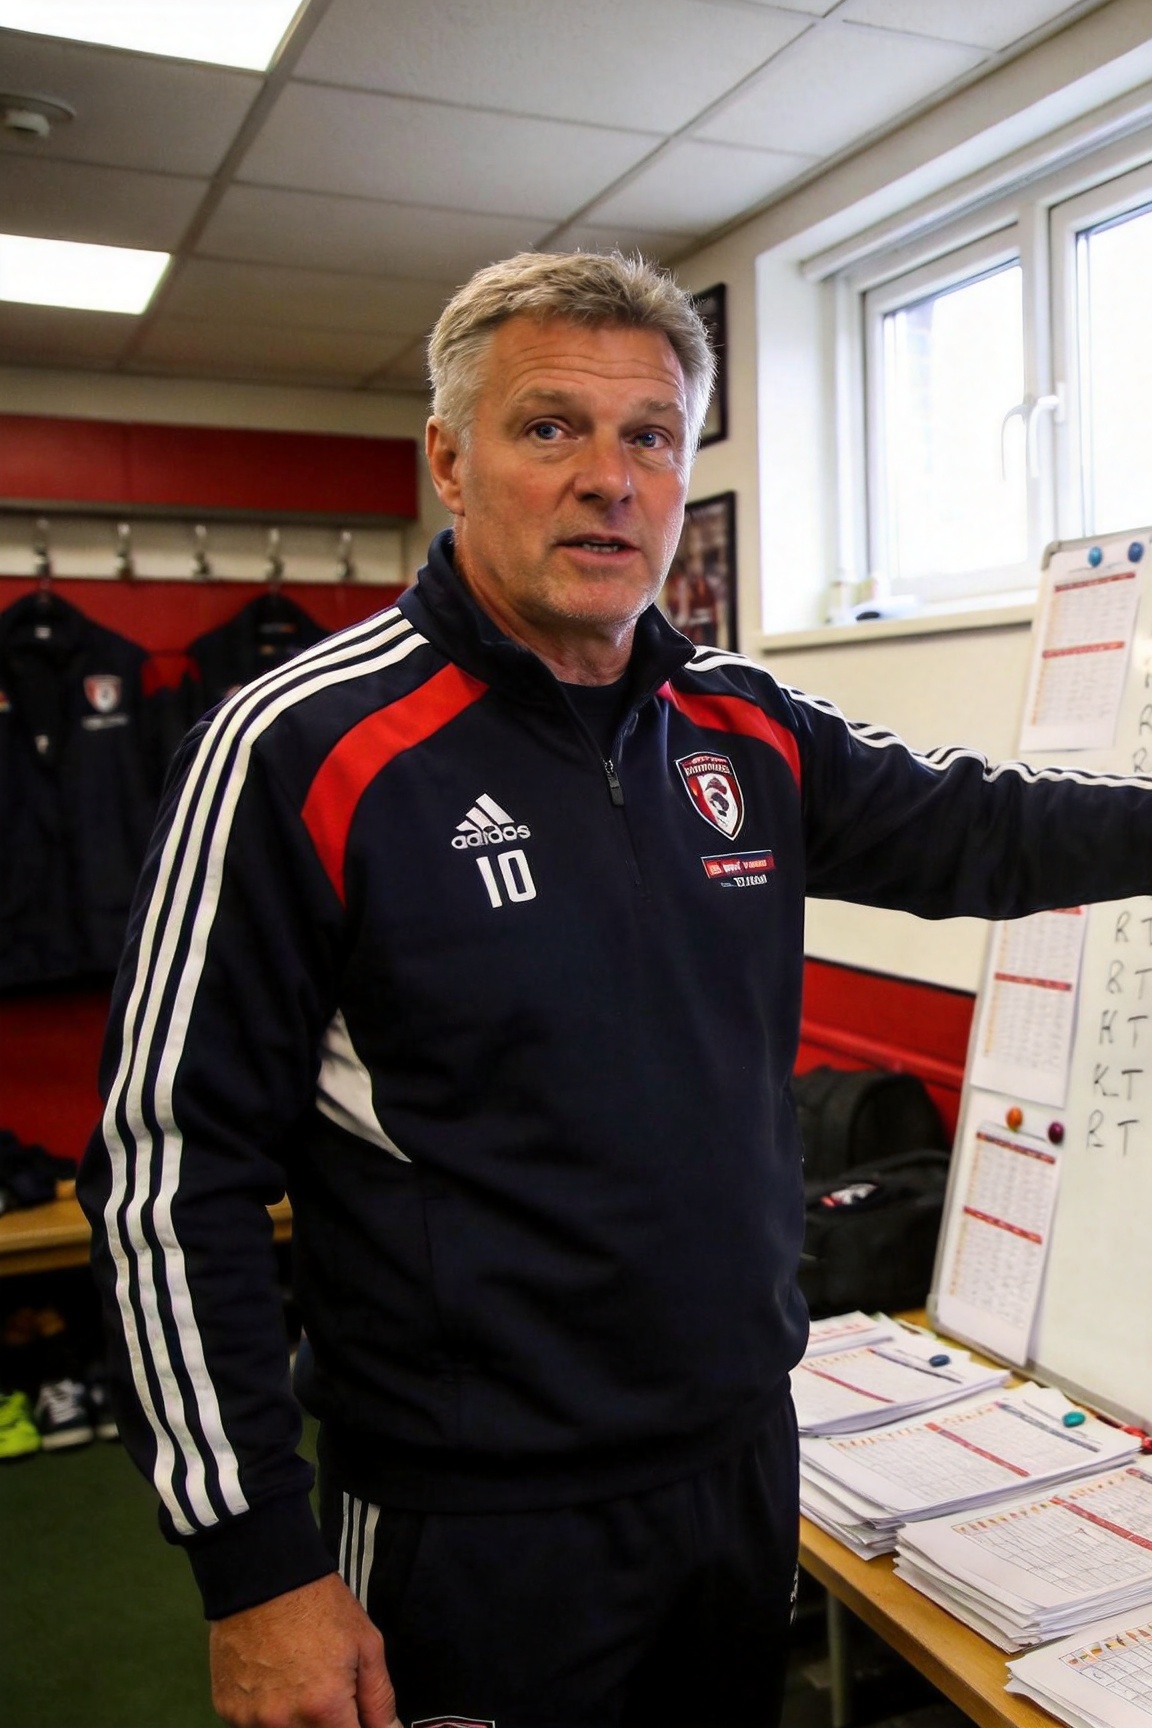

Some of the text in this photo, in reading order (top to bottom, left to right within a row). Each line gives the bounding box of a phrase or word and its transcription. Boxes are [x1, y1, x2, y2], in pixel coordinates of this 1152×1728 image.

[451, 824, 531, 850] adidas
[475, 849, 537, 909] 10
[1115, 911, 1130, 943] R
[1128, 1015, 1149, 1047] T
[1121, 1069, 1144, 1100] T
[1117, 1119, 1140, 1156] T
